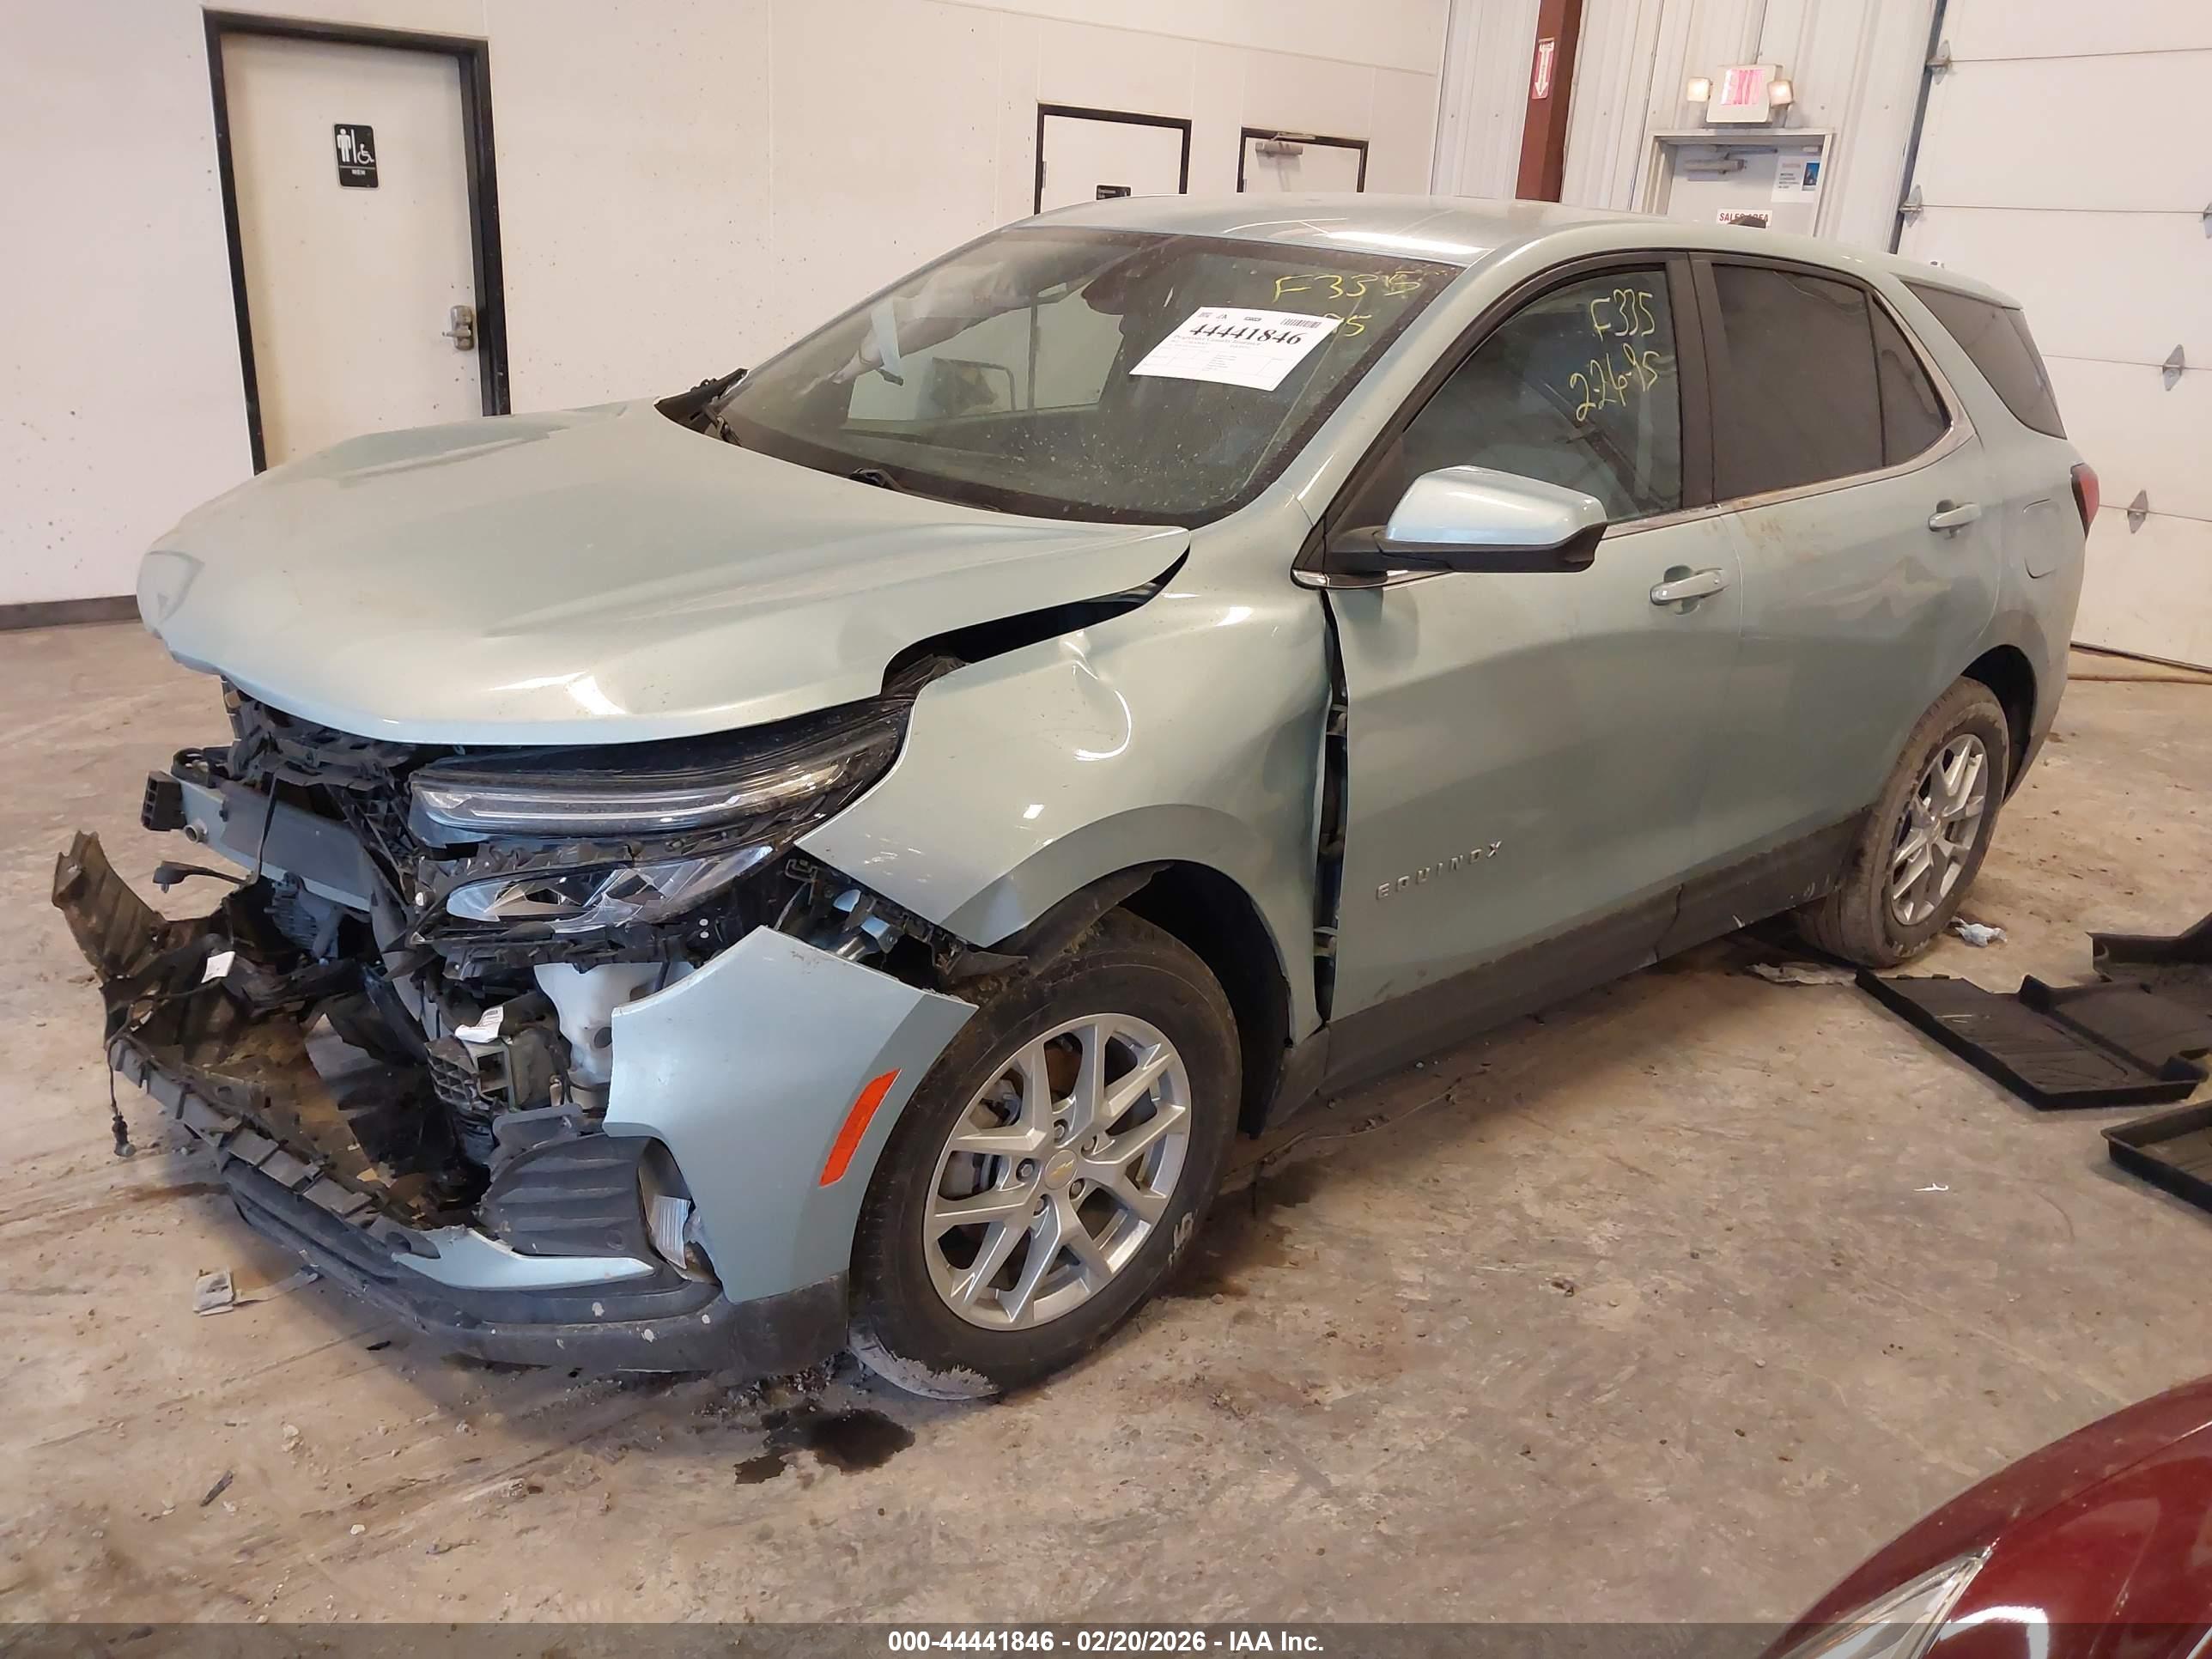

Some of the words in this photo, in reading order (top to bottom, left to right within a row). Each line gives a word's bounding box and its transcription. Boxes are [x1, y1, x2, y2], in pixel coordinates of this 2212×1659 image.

[1720, 69, 1765, 105] EXIT
[1190, 324, 1308, 345] 44441846
[1589, 288, 1656, 343] F335
[1376, 840, 1503, 900] EQUINOX
